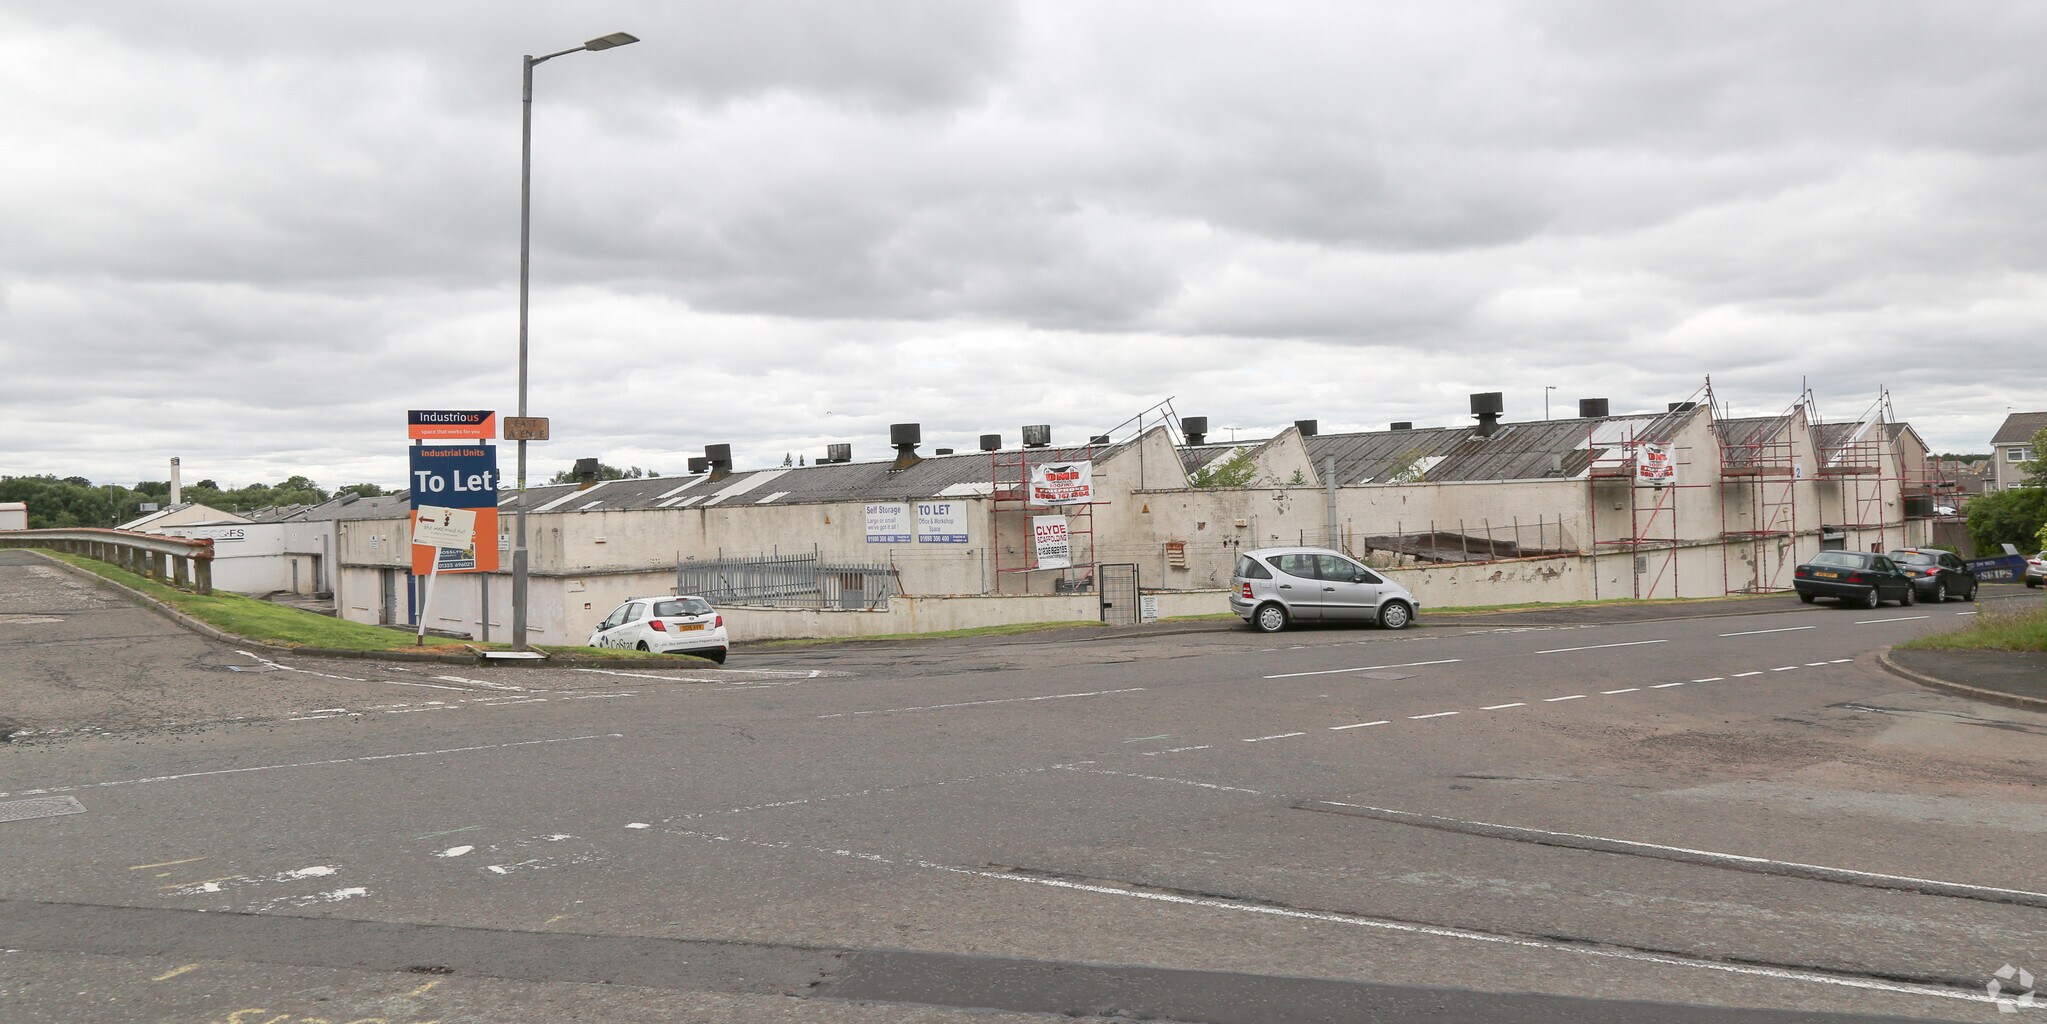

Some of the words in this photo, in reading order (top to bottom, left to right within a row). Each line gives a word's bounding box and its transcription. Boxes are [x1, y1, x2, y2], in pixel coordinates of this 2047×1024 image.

[420, 412, 480, 422] Industrious
[421, 449, 461, 457] Industrial
[463, 448, 485, 456] Units
[414, 470, 445, 493] To
[453, 469, 493, 492] Let
[1045, 471, 1079, 482] DMR
[866, 505, 878, 515] Self
[879, 505, 901, 516] Storage
[918, 504, 931, 515] TO
[933, 504, 950, 515] LET
[1036, 525, 1067, 536] CLYDE
[1037, 534, 1067, 543] SCAFFOLDING
[611, 638, 633, 650] CoStar
